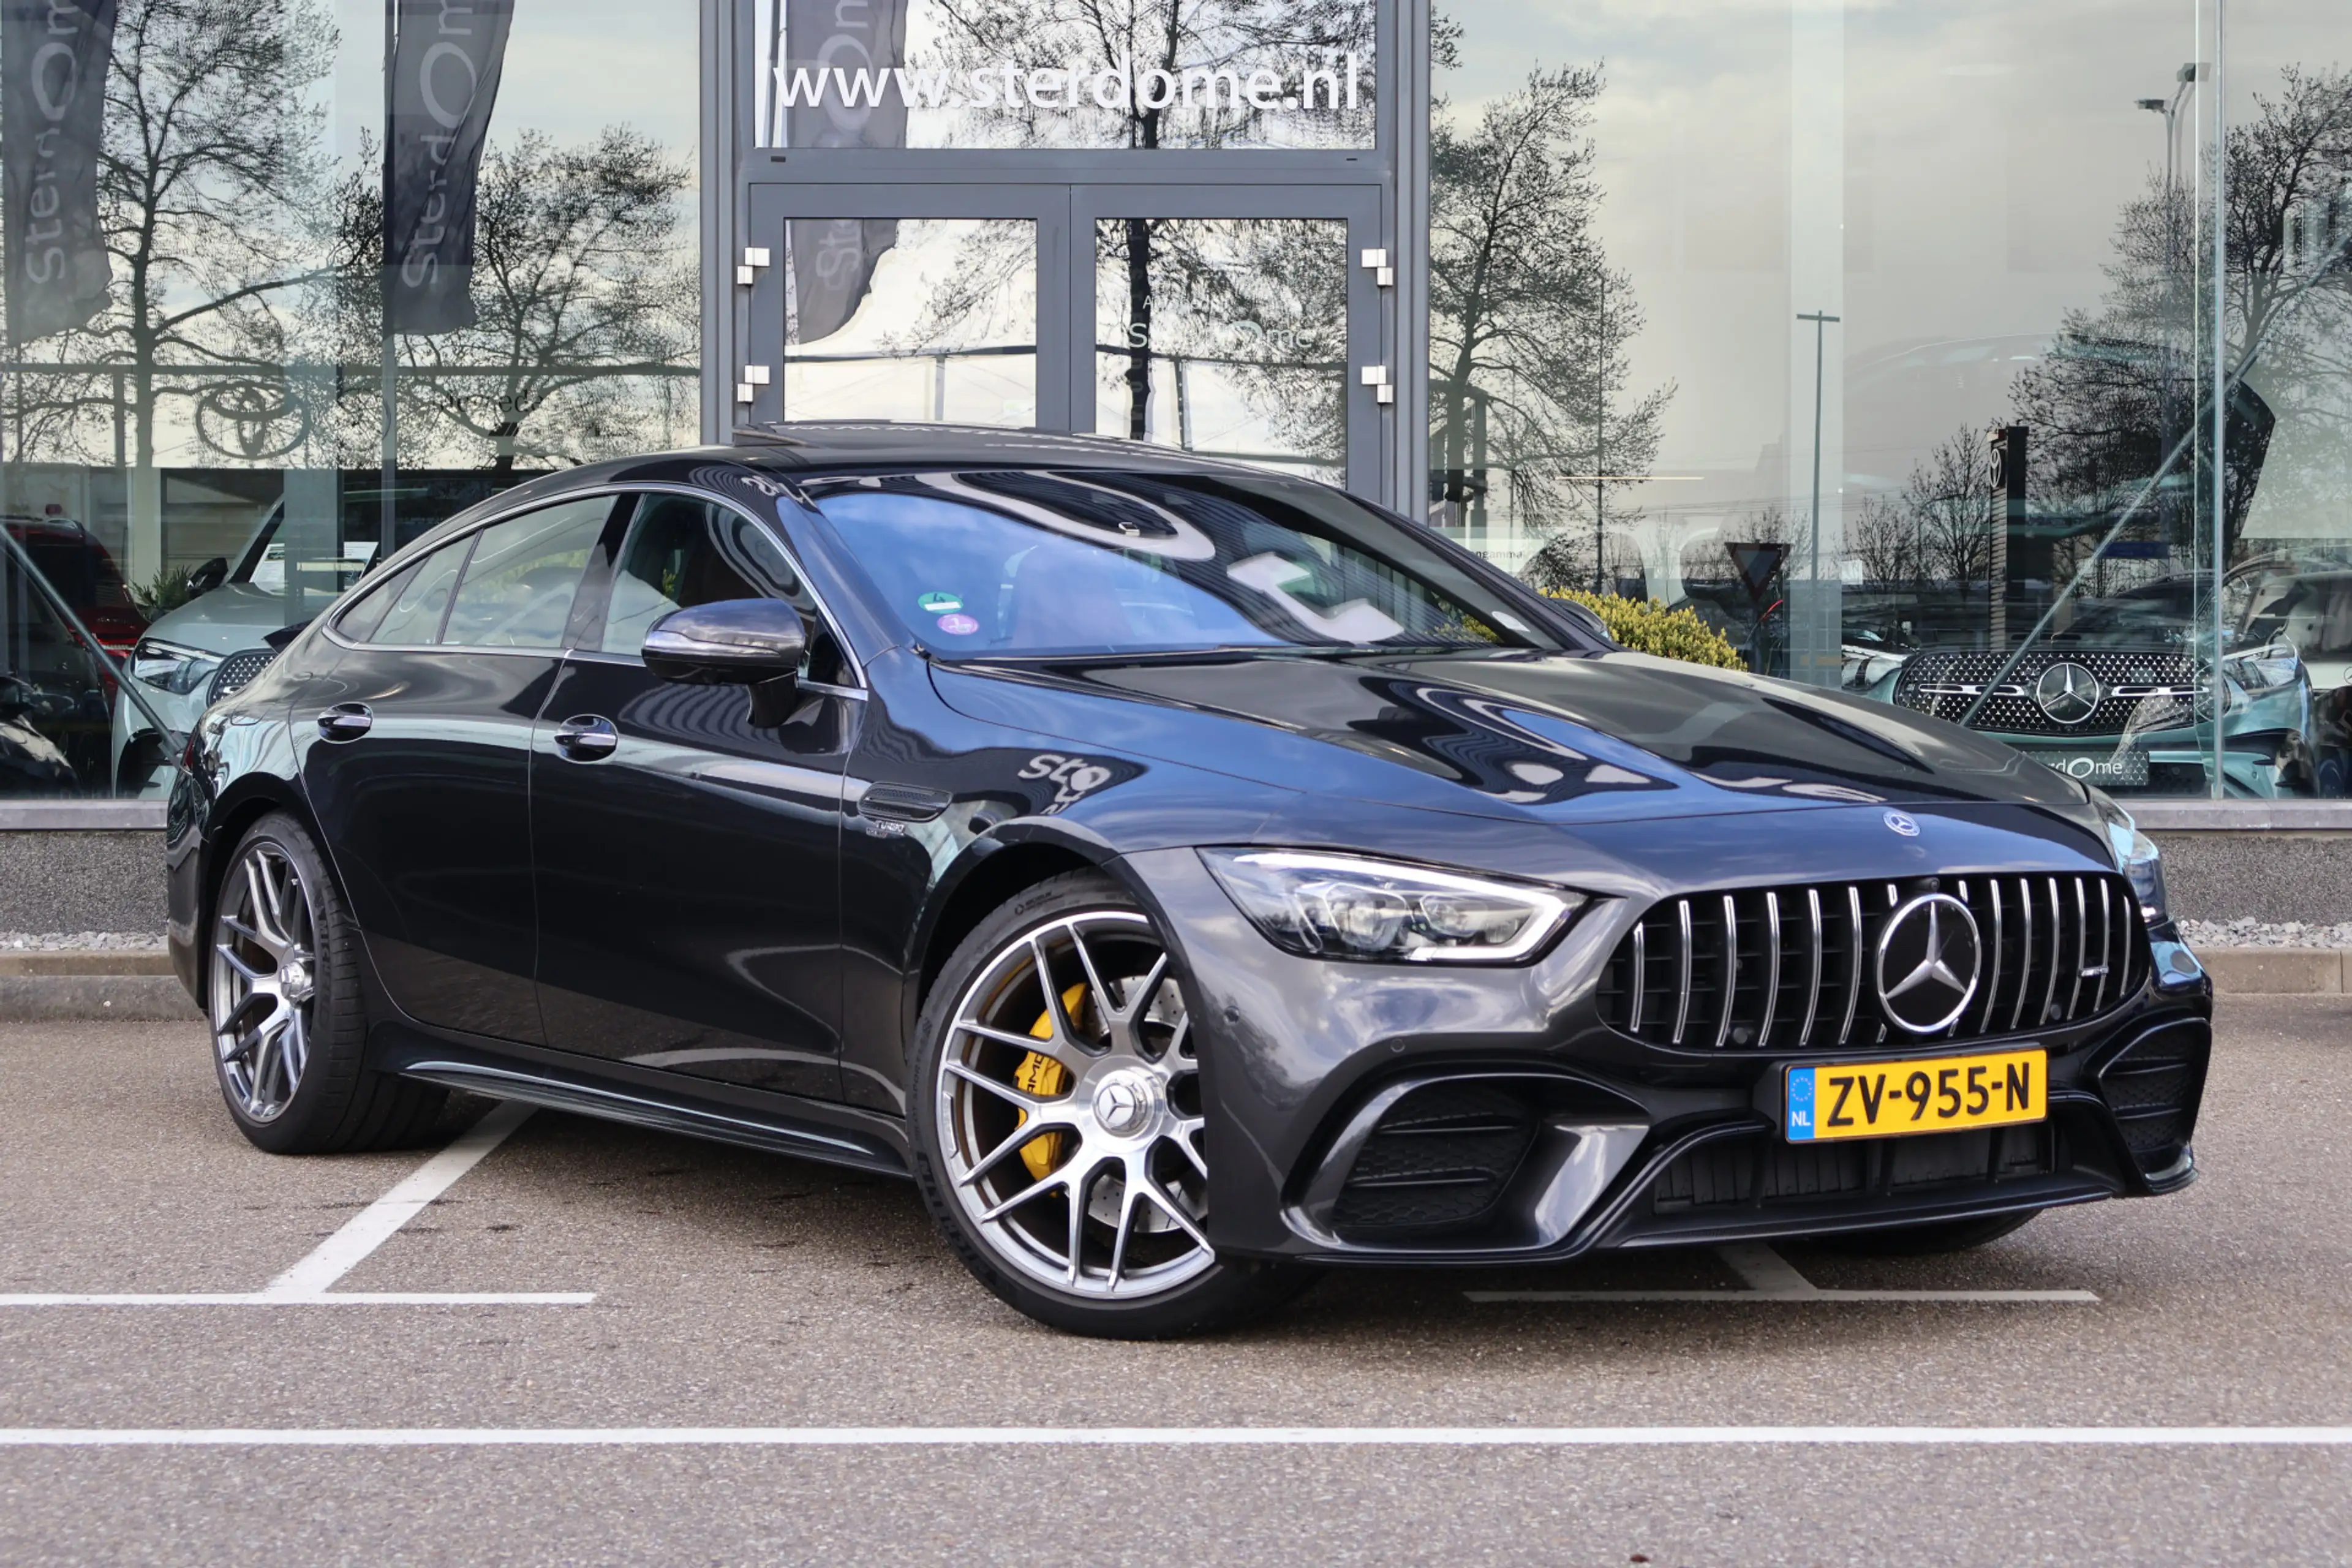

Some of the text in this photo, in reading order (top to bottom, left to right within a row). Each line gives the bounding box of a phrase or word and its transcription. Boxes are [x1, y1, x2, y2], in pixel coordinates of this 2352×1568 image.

[772, 51, 1357, 109] www.sterdome.nl
[1792, 1110, 1811, 1128] NL
[1827, 1061, 2030, 1127] ZV-955-N
